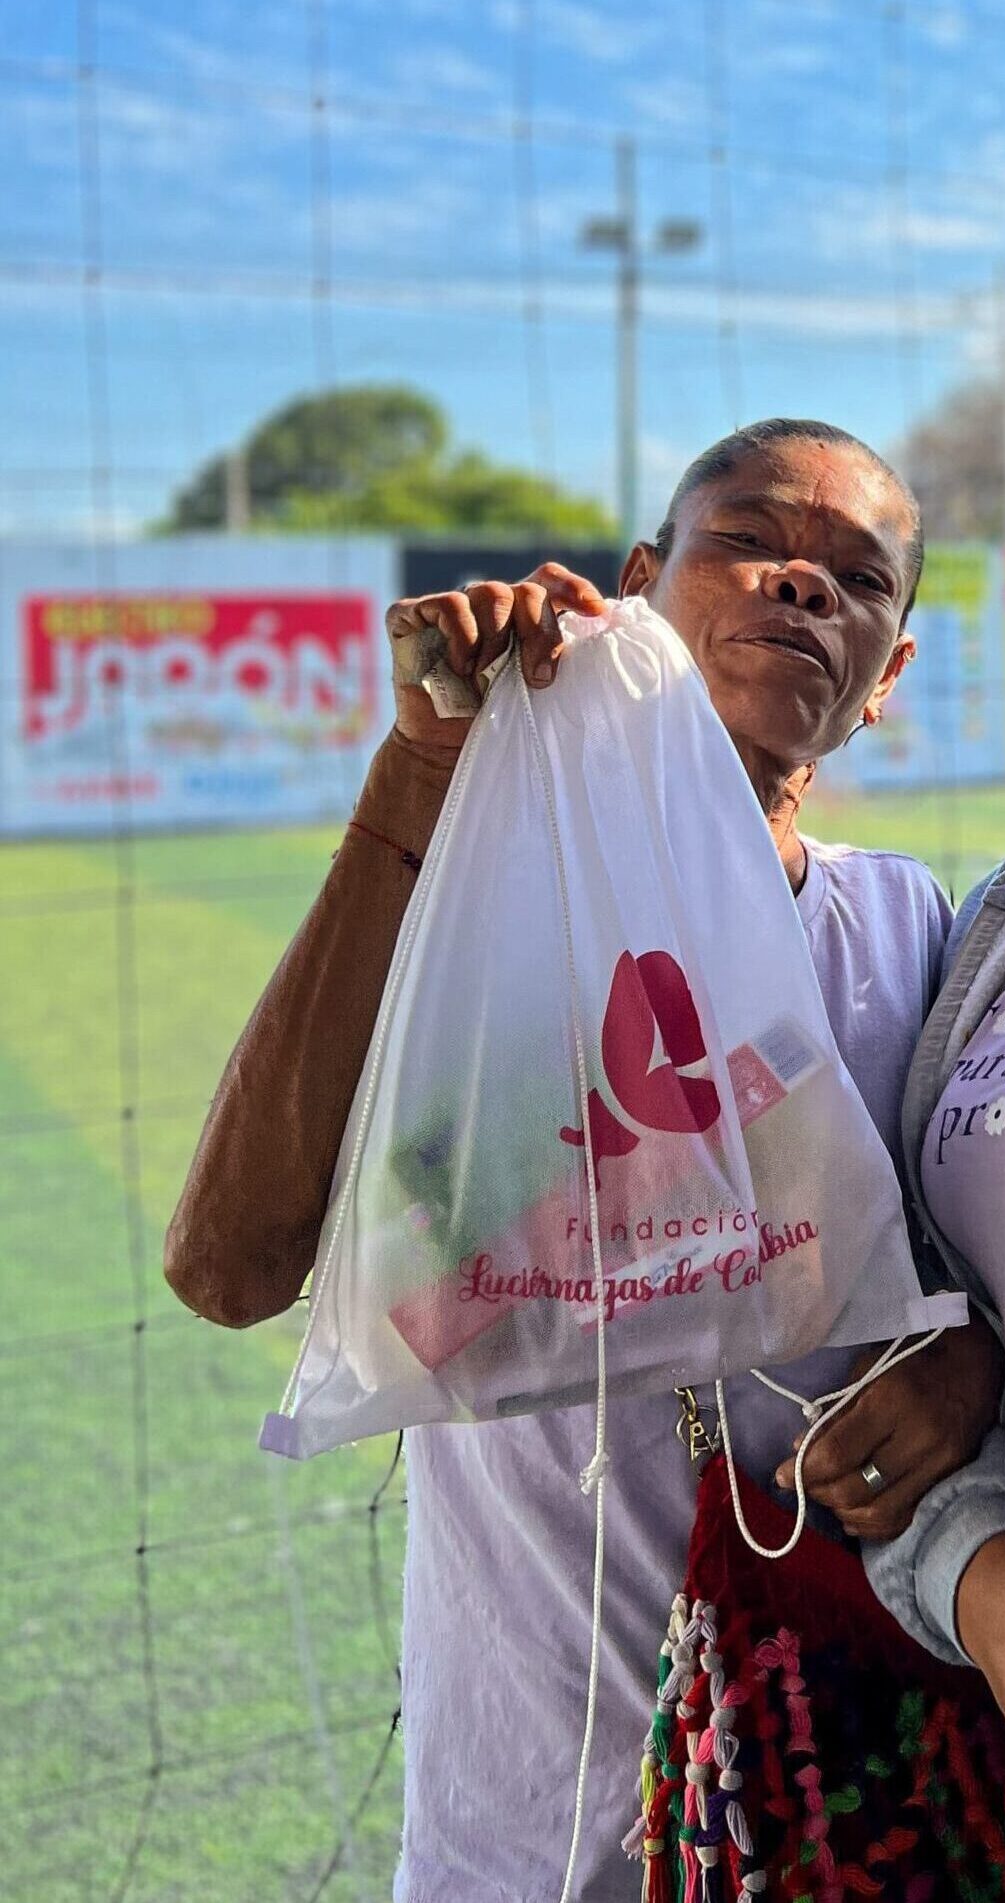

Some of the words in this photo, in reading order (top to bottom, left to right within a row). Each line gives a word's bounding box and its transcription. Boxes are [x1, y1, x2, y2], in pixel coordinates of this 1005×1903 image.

[457, 1252, 657, 1322] Luciérnagas
[663, 1257, 704, 1296] de
[713, 1220, 819, 1293] Cobia
